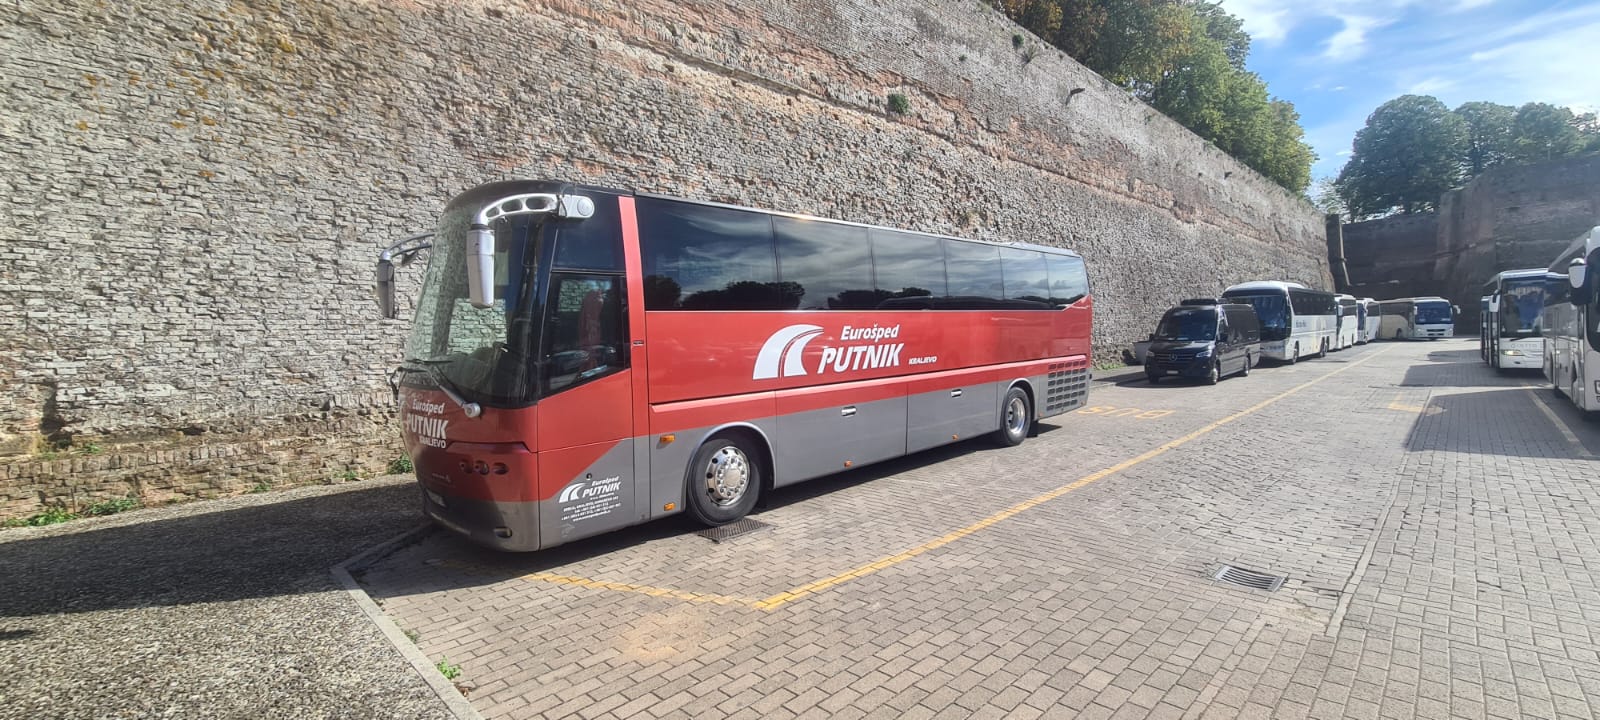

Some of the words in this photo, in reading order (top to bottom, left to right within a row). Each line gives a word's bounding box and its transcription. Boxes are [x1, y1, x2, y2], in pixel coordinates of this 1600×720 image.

[840, 323, 900, 343] Eurošped
[817, 342, 904, 374] PUTNIK
[908, 355, 937, 365] KRALJEVO
[412, 398, 446, 415] Eurošped
[407, 412, 448, 440] PUTNIK
[581, 481, 622, 498] PUTNIK
[591, 475, 620, 487] Eurošped
